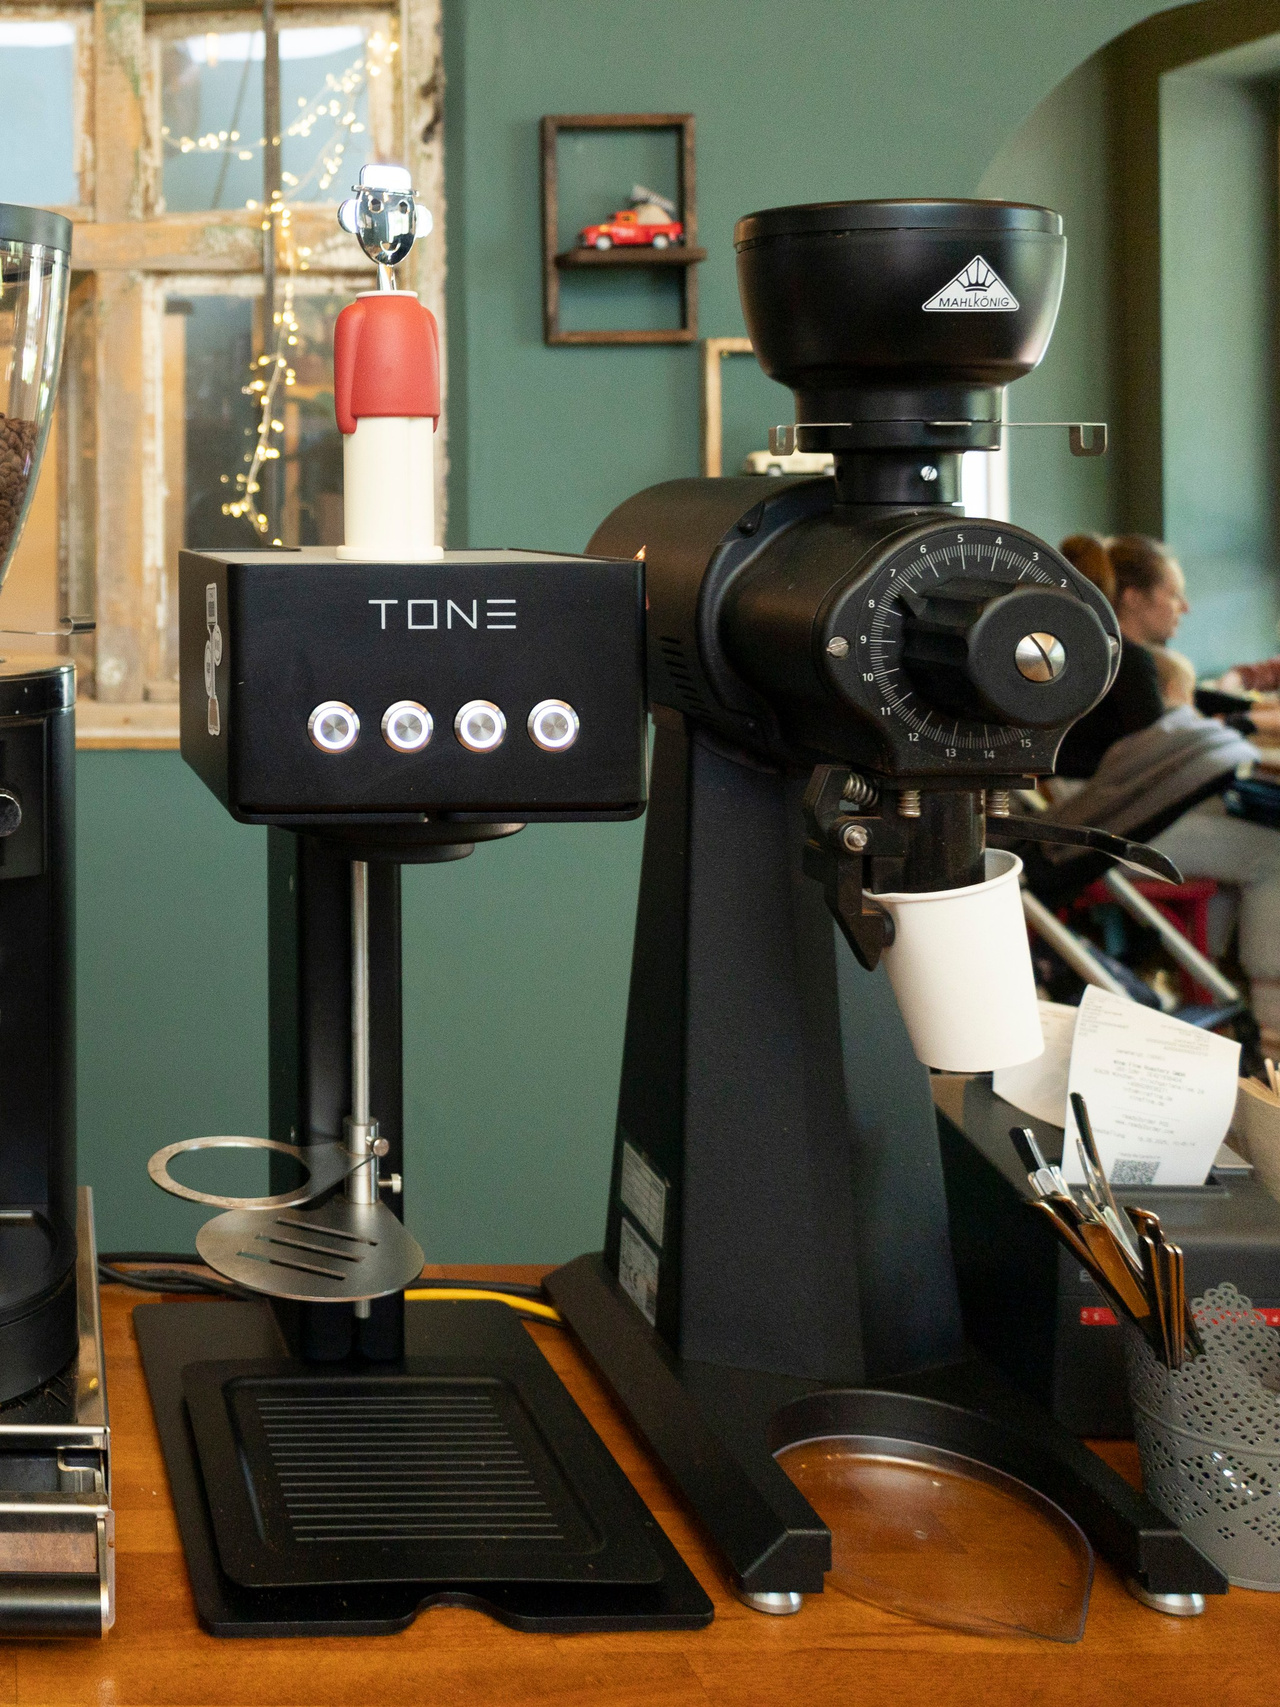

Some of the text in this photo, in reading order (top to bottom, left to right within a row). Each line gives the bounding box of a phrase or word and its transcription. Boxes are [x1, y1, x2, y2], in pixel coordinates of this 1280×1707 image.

[938, 292, 1010, 308] MAHLKÖNIG
[956, 534, 964, 543] 5
[994, 536, 1003, 545] 4
[919, 545, 927, 554] 6
[1032, 552, 1039, 561] 3
[889, 569, 897, 578] 7
[1060, 579, 1068, 588] 2
[868, 599, 875, 608] 8
[368, 599, 517, 630] TONE
[860, 635, 867, 644] 9
[862, 672, 874, 682] 10
[880, 707, 891, 716] 11
[907, 732, 920, 742] 12
[1020, 738, 1032, 748] 15
[945, 748, 957, 758] 13
[983, 750, 995, 759] 14
